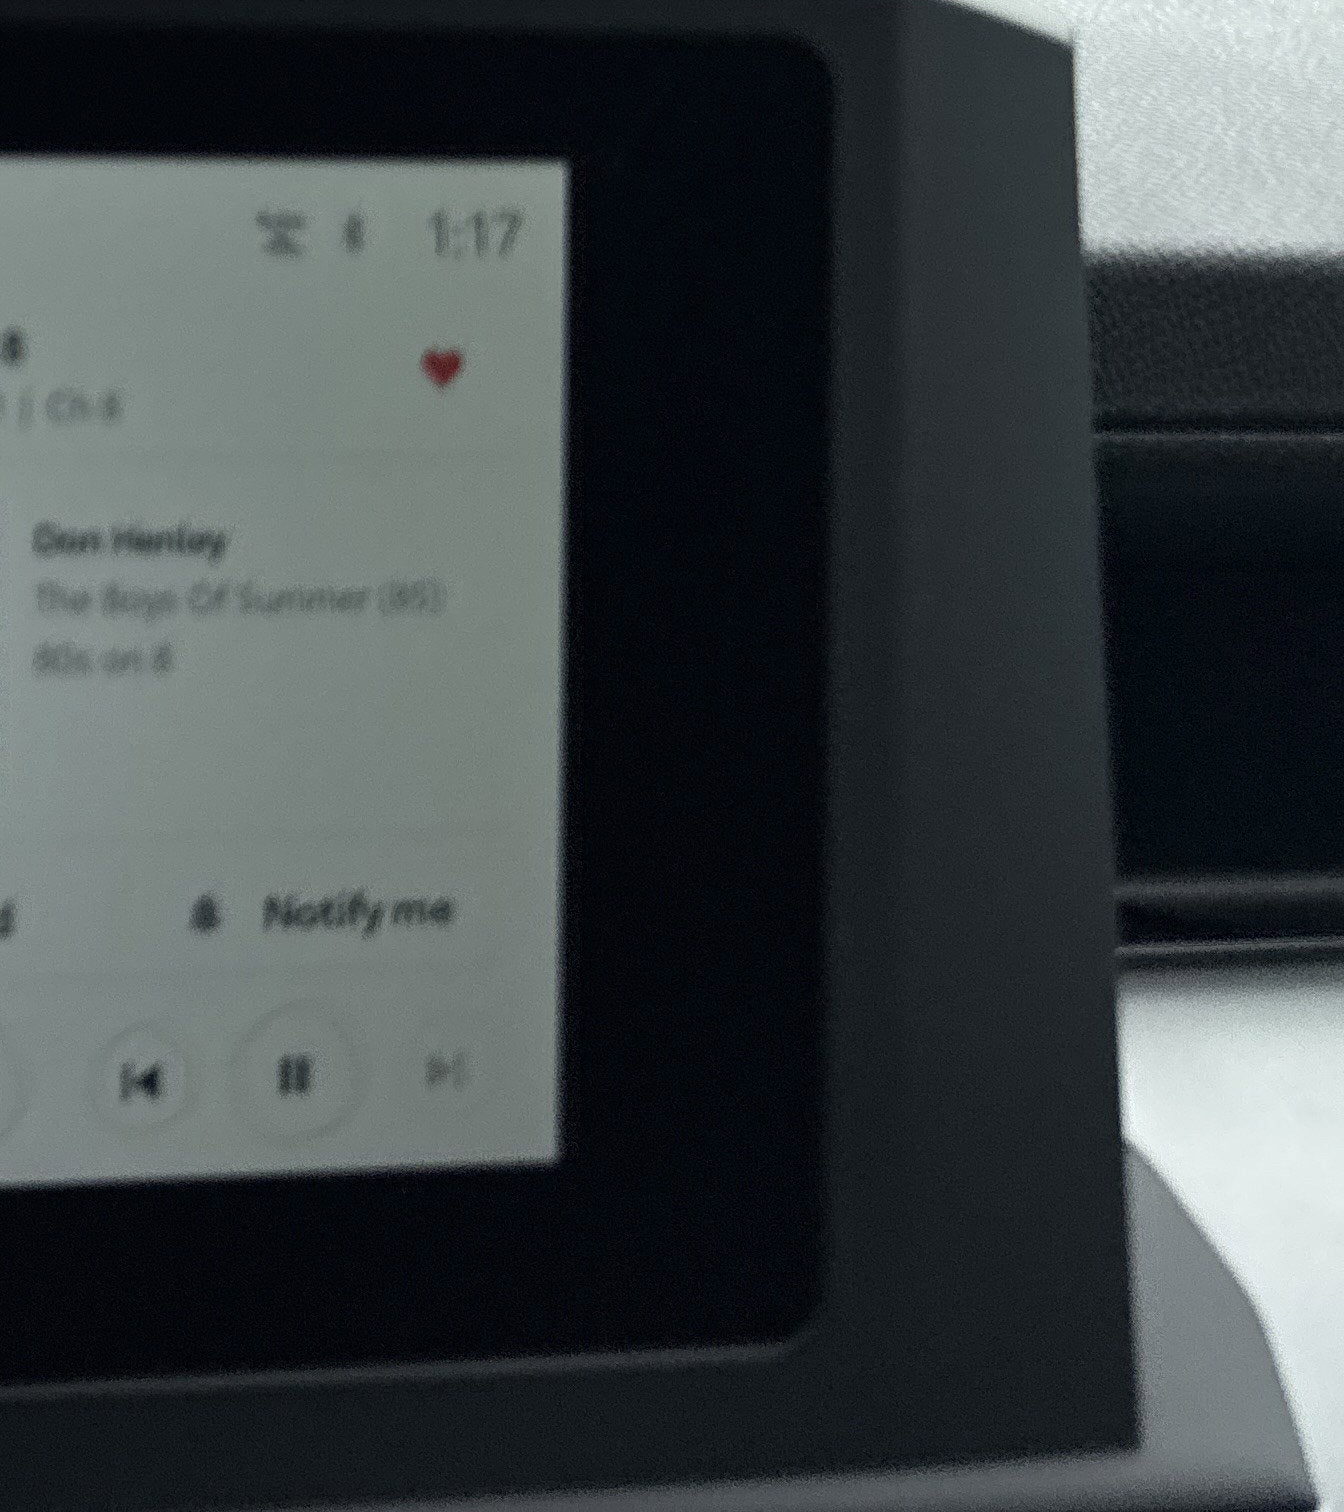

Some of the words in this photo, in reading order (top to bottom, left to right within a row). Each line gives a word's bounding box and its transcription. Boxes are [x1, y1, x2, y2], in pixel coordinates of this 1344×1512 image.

[428, 210, 525, 259] 1:17
[0, 326, 26, 365] 8
[46, 390, 94, 424] Ch
[33, 522, 101, 556] Don
[113, 523, 229, 565] Henley
[238, 581, 369, 615] Summer
[264, 891, 384, 938] Notify
[391, 897, 455, 928] me
